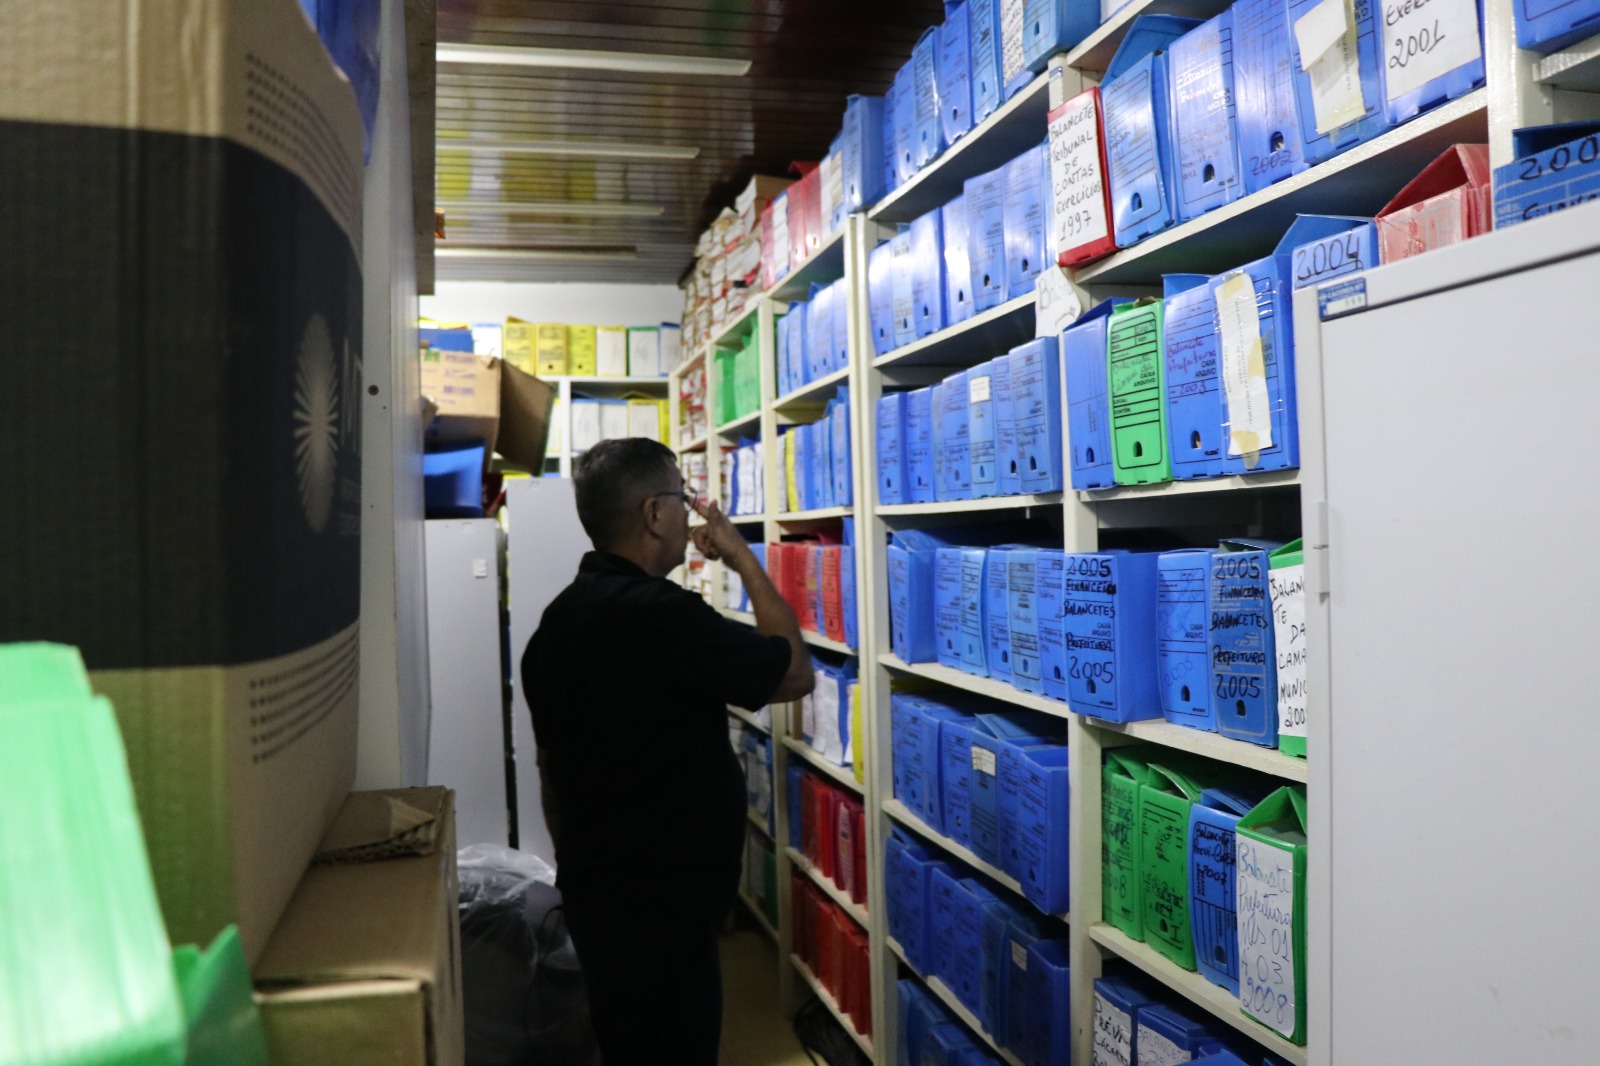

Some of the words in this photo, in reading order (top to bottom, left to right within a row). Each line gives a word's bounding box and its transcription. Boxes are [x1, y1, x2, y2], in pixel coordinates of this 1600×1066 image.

[1389, 19, 1445, 70] 2001
[1055, 163, 1094, 196] CONTAS
[1064, 156, 1078, 175] DE
[1060, 209, 1091, 242] 1997
[1297, 232, 1360, 281] 2004
[1066, 556, 1112, 578] 2005
[1215, 556, 1260, 580] 2005
[1069, 656, 1114, 684] 2005
[1216, 673, 1260, 699] 2005
[1256, 955, 1284, 985] 03
[1243, 977, 1288, 1025] 2008
